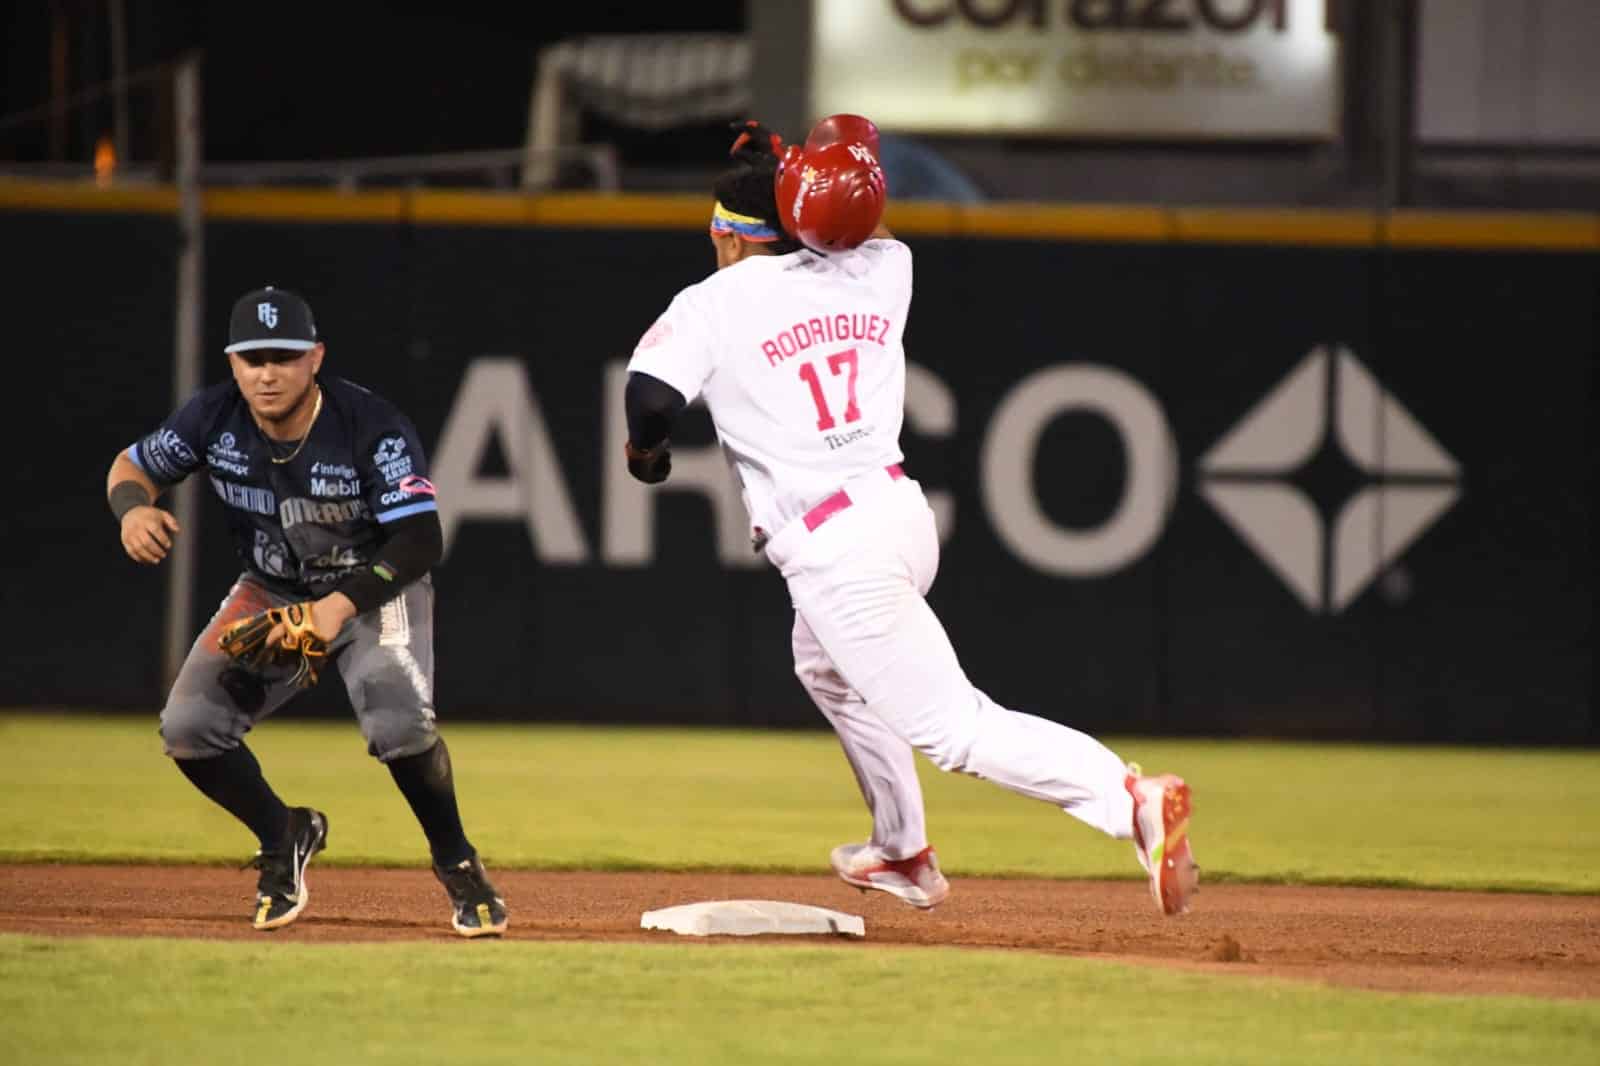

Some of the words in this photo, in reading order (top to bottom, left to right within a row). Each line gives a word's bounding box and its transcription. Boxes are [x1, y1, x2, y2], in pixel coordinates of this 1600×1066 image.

[761, 313, 890, 367] RODRIGUEZ
[799, 348, 862, 432] 17
[311, 477, 360, 497] Mobil
